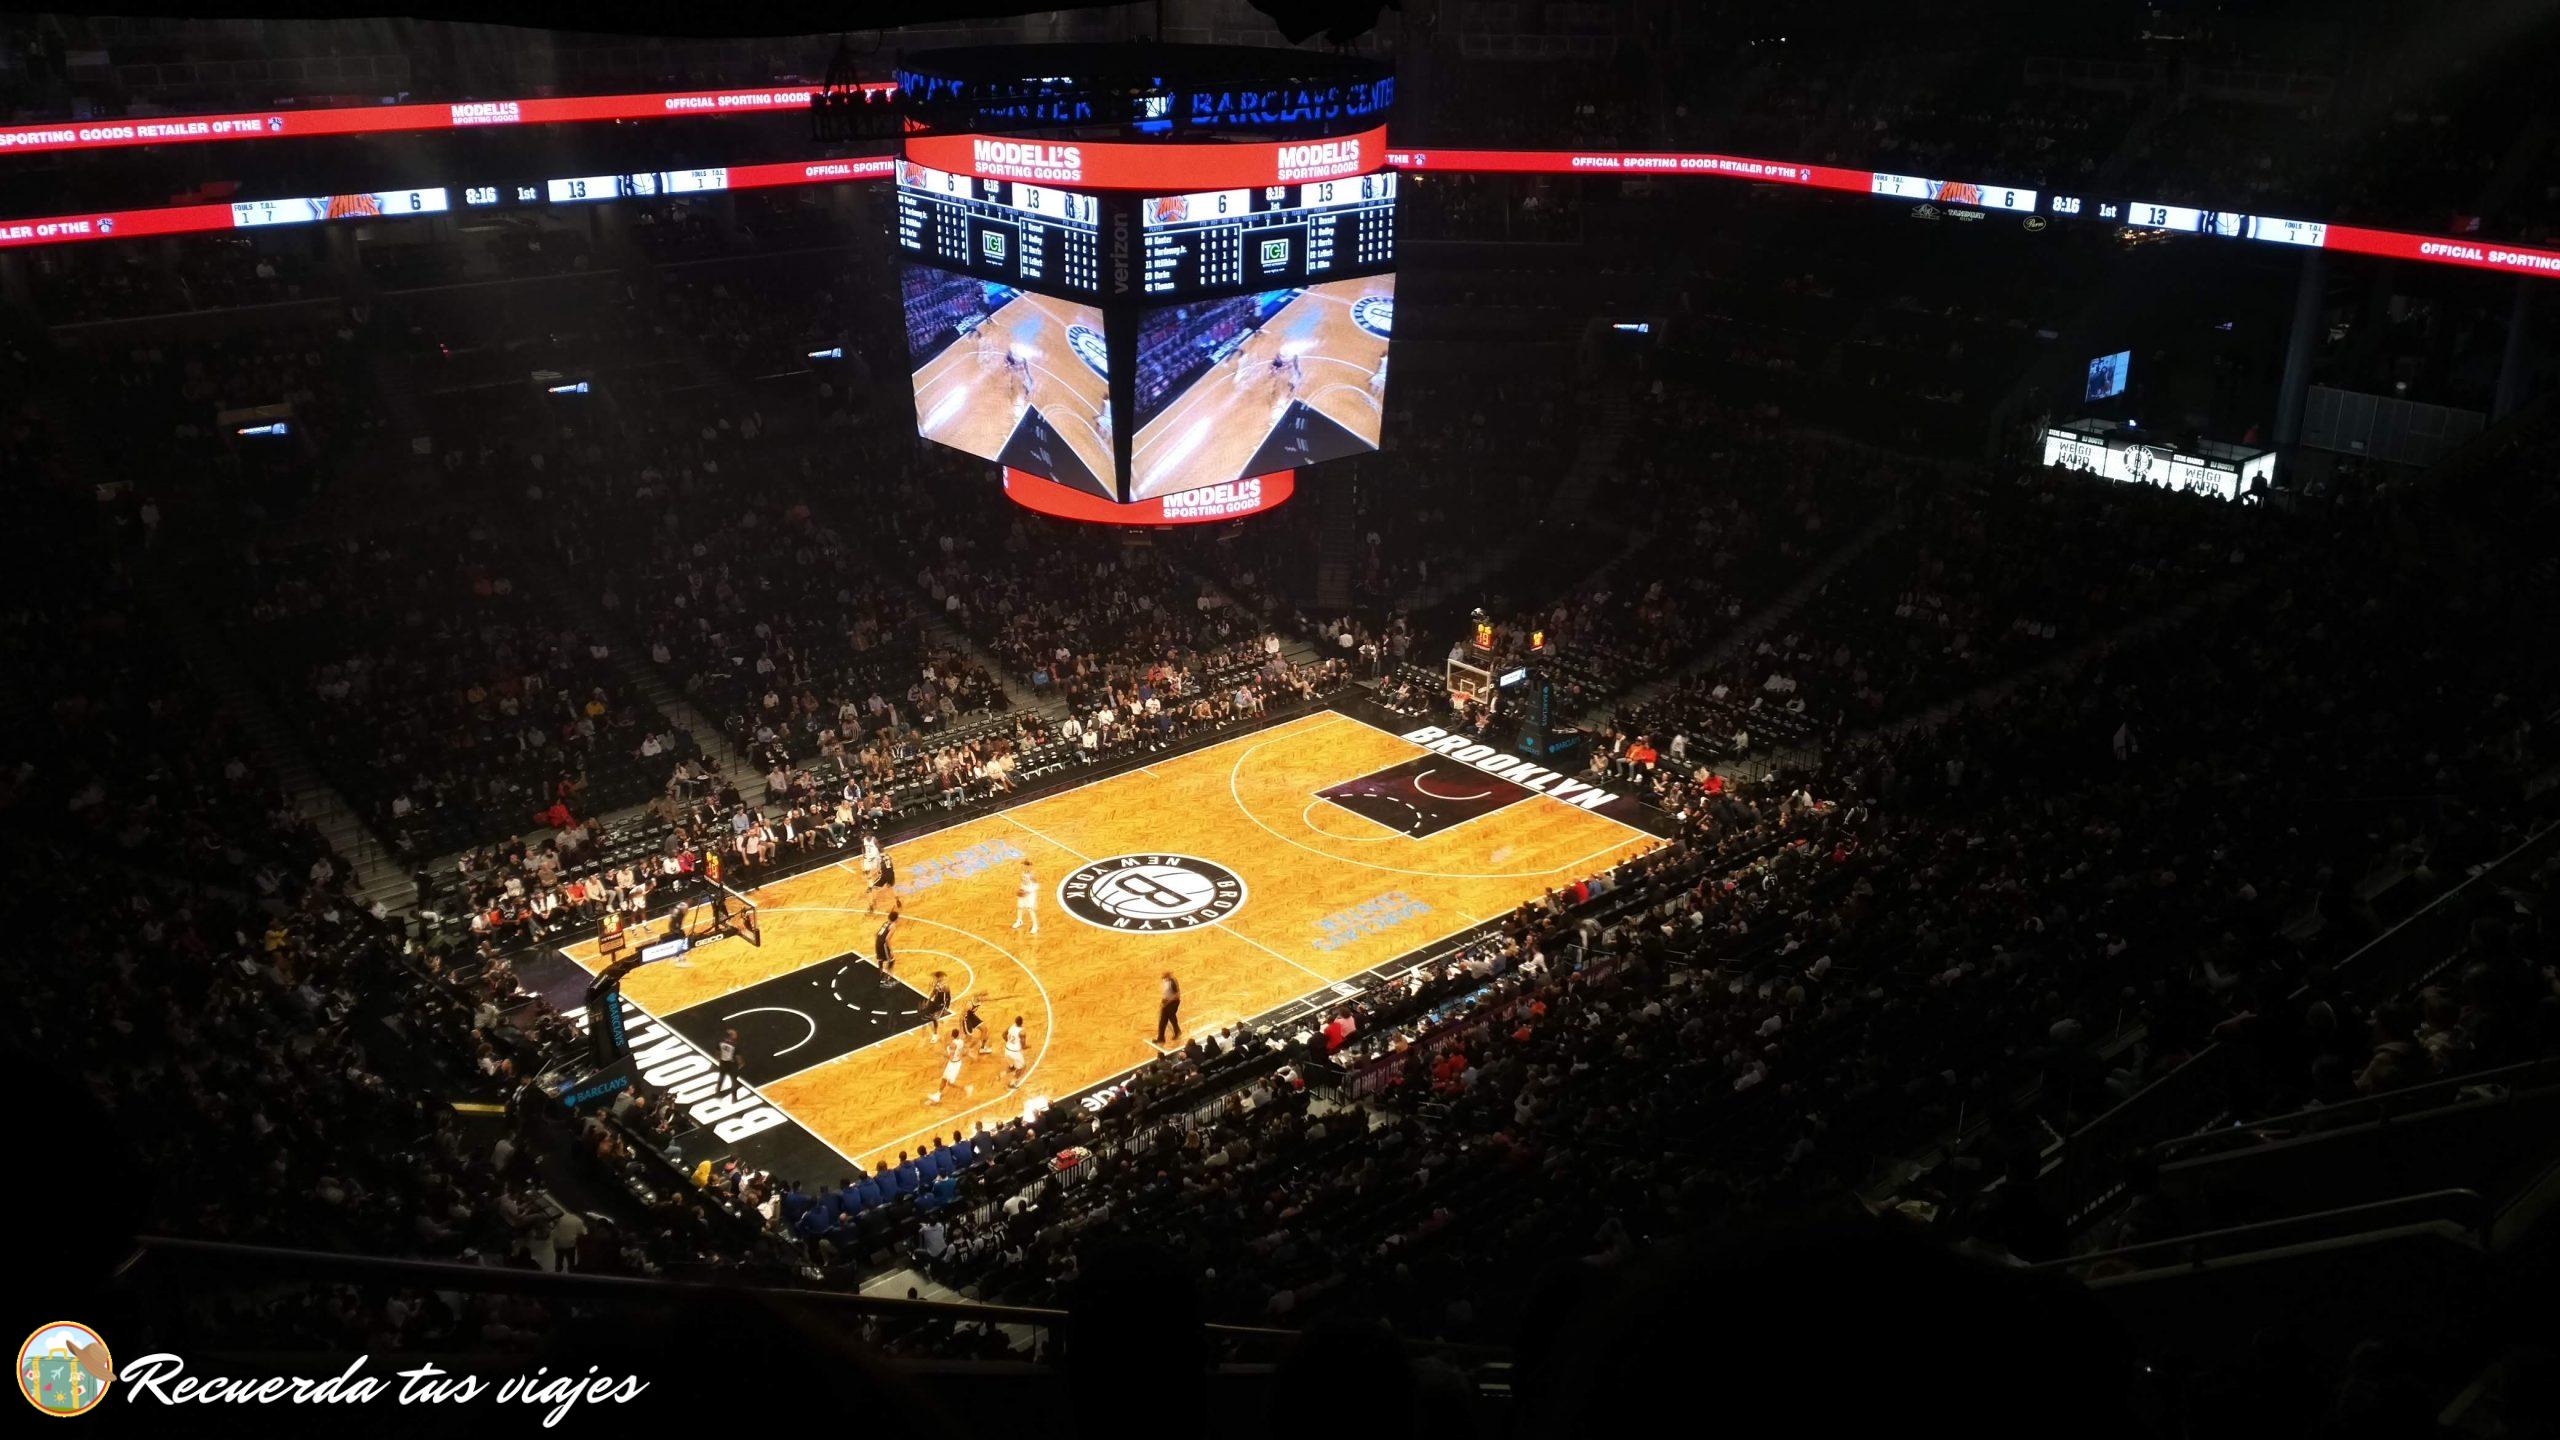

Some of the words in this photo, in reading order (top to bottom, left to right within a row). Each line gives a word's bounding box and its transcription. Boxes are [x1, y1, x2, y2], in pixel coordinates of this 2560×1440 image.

[452, 103, 518, 117] MODELL'S
[665, 97, 714, 109] OFFICIAL
[718, 95, 771, 106] SPORTING
[774, 93, 810, 103] GOODS
[1191, 87, 1338, 124] BARCLAYS
[453, 116, 492, 124] SPORTING
[0, 130, 75, 146] SPORTING
[80, 127, 134, 140] GOODS
[137, 122, 208, 137] RETAILER
[213, 122, 231, 133] OF
[232, 120, 261, 131] THE
[974, 140, 1080, 168] MODELL'S
[1278, 140, 1359, 168] MODELL'S
[1388, 154, 1409, 164] THE
[806, 164, 850, 177] OFFICIAL
[853, 161, 894, 172] SPORTIN
[975, 162, 1032, 178] SPORTING
[1034, 167, 1082, 181] GOODS
[1278, 166, 1329, 180] SPORTING
[1331, 161, 1358, 174] GOODS
[1572, 157, 1619, 167] OFFICIAL
[1624, 158, 1676, 167] SPORTING
[1681, 158, 1717, 168] GOODS
[1720, 161, 1762, 174] RETAILER
[1765, 166, 1777, 175] OF
[1778, 167, 1795, 177] THE
[717, 177, 721, 186] 7
[244, 213, 249, 223] 1
[267, 211, 272, 221] 7
[410, 193, 421, 210] 6
[466, 187, 496, 204] 8:16
[518, 187, 536, 200] 1st
[568, 181, 585, 198] 13
[1027, 189, 1039, 208] 13
[1219, 195, 1226, 213] 6
[1266, 186, 1285, 200] 8:16
[1319, 183, 1333, 202] 13
[1878, 182, 1882, 191] 1
[1896, 184, 1899, 193] 7
[2005, 191, 2014, 207] 6
[2053, 196, 2080, 213] 8:16
[2100, 204, 2116, 218] 1st
[2148, 208, 2167, 226] 13
[0, 226, 32, 239] LER
[37, 224, 57, 235] OF
[59, 222, 89, 234] THE
[2312, 234, 2317, 244] 7
[1110, 213, 1128, 294] verizon
[2421, 242, 2483, 260] OFFICIAL
[2488, 251, 2560, 270] SPORTING
[2060, 442, 2074, 452] WE
[2078, 446, 2091, 455] GO
[2186, 468, 2202, 479] WE
[2207, 472, 2220, 482] GO
[1163, 479, 1260, 508] MODELL'S
[1163, 505, 1223, 518] SPORTING
[1226, 497, 1260, 513] GOODS
[1402, 726, 1619, 810] BROOKLYN
[1121, 856, 1180, 867] NEW
[1067, 866, 1108, 899] YORK
[1113, 881, 1237, 930] BROOKLYN
[695, 934, 723, 947] GEICO
[609, 1003, 624, 1046] BARCLAYS
[577, 1076, 627, 1101] BARCLAYS
